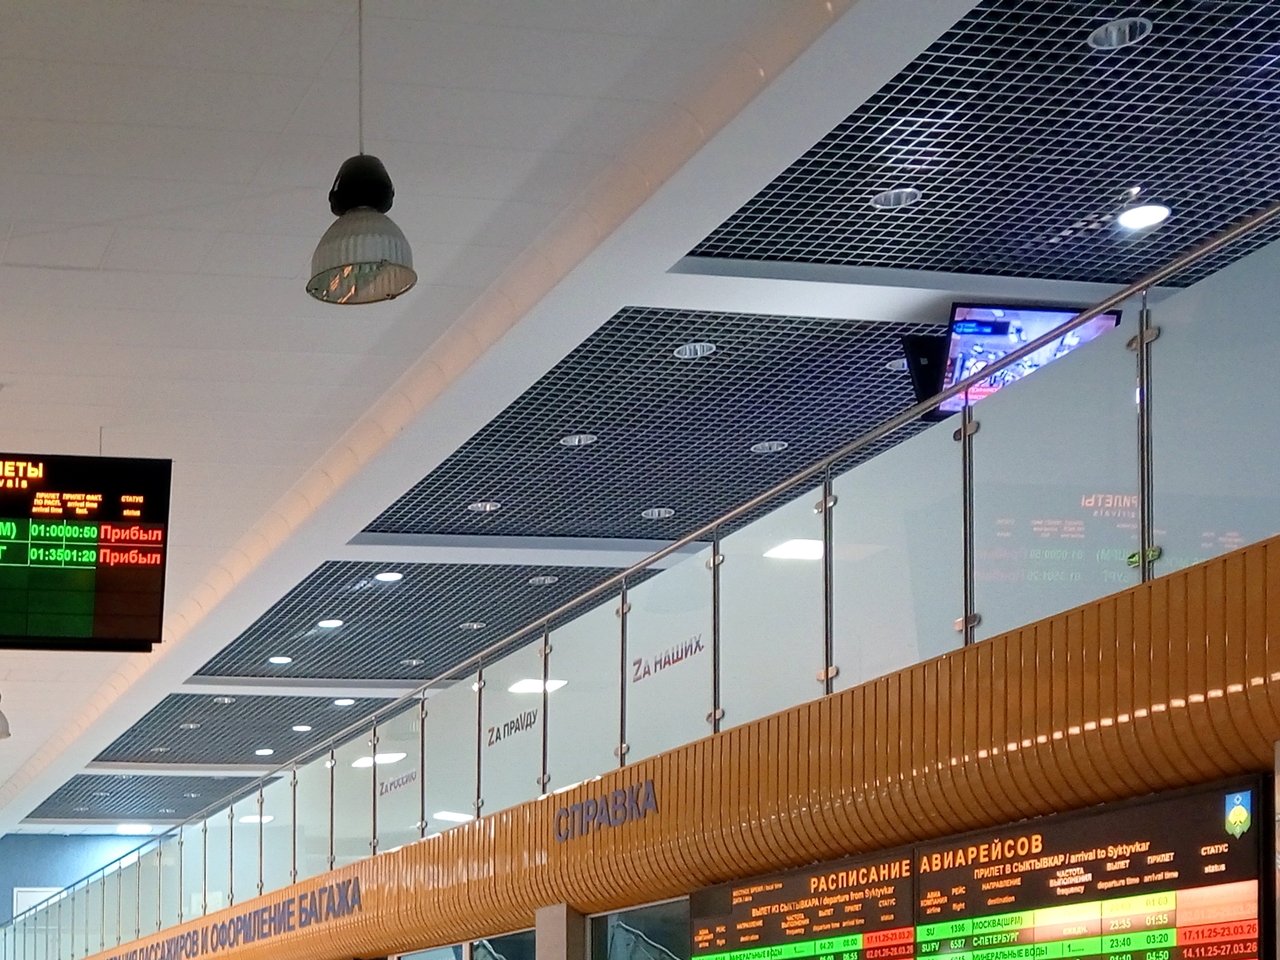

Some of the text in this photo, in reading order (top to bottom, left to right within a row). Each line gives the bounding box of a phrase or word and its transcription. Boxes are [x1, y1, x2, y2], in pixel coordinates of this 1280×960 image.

[36, 492, 60, 500] ПРИЛЕТ
[31, 524, 64, 537] 01:00
[65, 526, 98, 538] 00:50
[100, 525, 162, 542] Прибыл
[30, 548, 64, 560] 01:35
[64, 550, 96, 562] 01:20
[100, 549, 160, 566] Прибыл
[554, 779, 659, 843] СПРАВКА
[1201, 844, 1229, 856] СТАТУС
[810, 859, 911, 893] РАСПИСАНИЕ
[920, 834, 1043, 874] АВИАРЕЙСОВ
[974, 840, 1150, 880] ПРИЛЕТ В СЫКТЫВКАР arrival to Syktyvkar
[1106, 860, 1130, 872] ВЫЛЕТ
[1147, 852, 1175, 866] ПРИЛЕТ
[1057, 867, 1084, 878] ЧАСТОТА
[1144, 872, 1164, 884] arrival
[982, 877, 1021, 891] НАПРАВЛЕНИЕ
[1050, 873, 1092, 888] ВЫПОЛНЕНИЯ
[951, 886, 966, 896] РЕЙС
[200, 927, 209, 954] И
[210, 898, 295, 950] ОФОРМЛЕНИЕ
[298, 876, 362, 927] БАГАЖА
[973, 914, 1168, 946] С-ПЕТЕРБУРГ 01:35
[1110, 934, 1168, 948] 23:40 03:20
